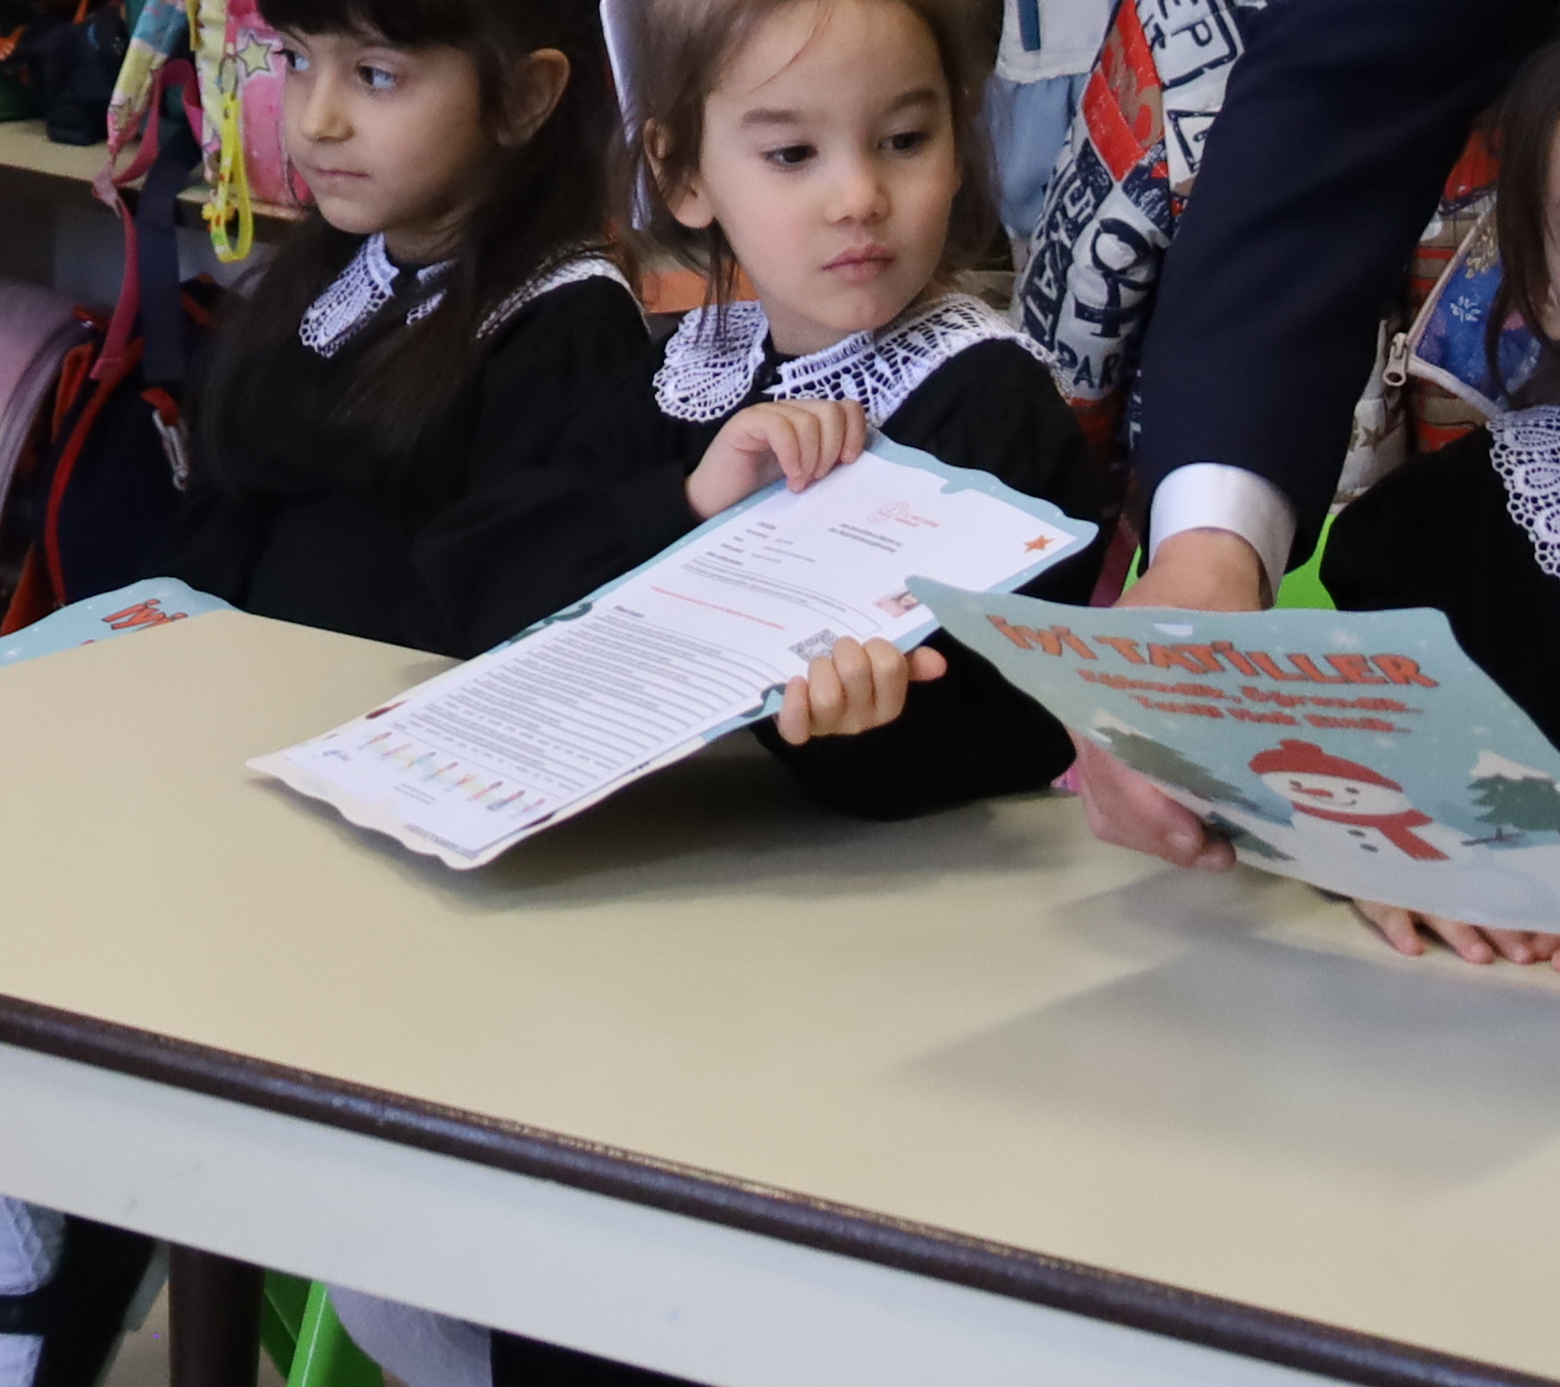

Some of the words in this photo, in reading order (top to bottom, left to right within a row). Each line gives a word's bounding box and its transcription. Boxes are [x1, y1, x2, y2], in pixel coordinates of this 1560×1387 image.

[1026, 178, 1096, 340] SKAT
[1055, 341, 1122, 389] PAR
[1092, 635, 1441, 689] TATİLLER
